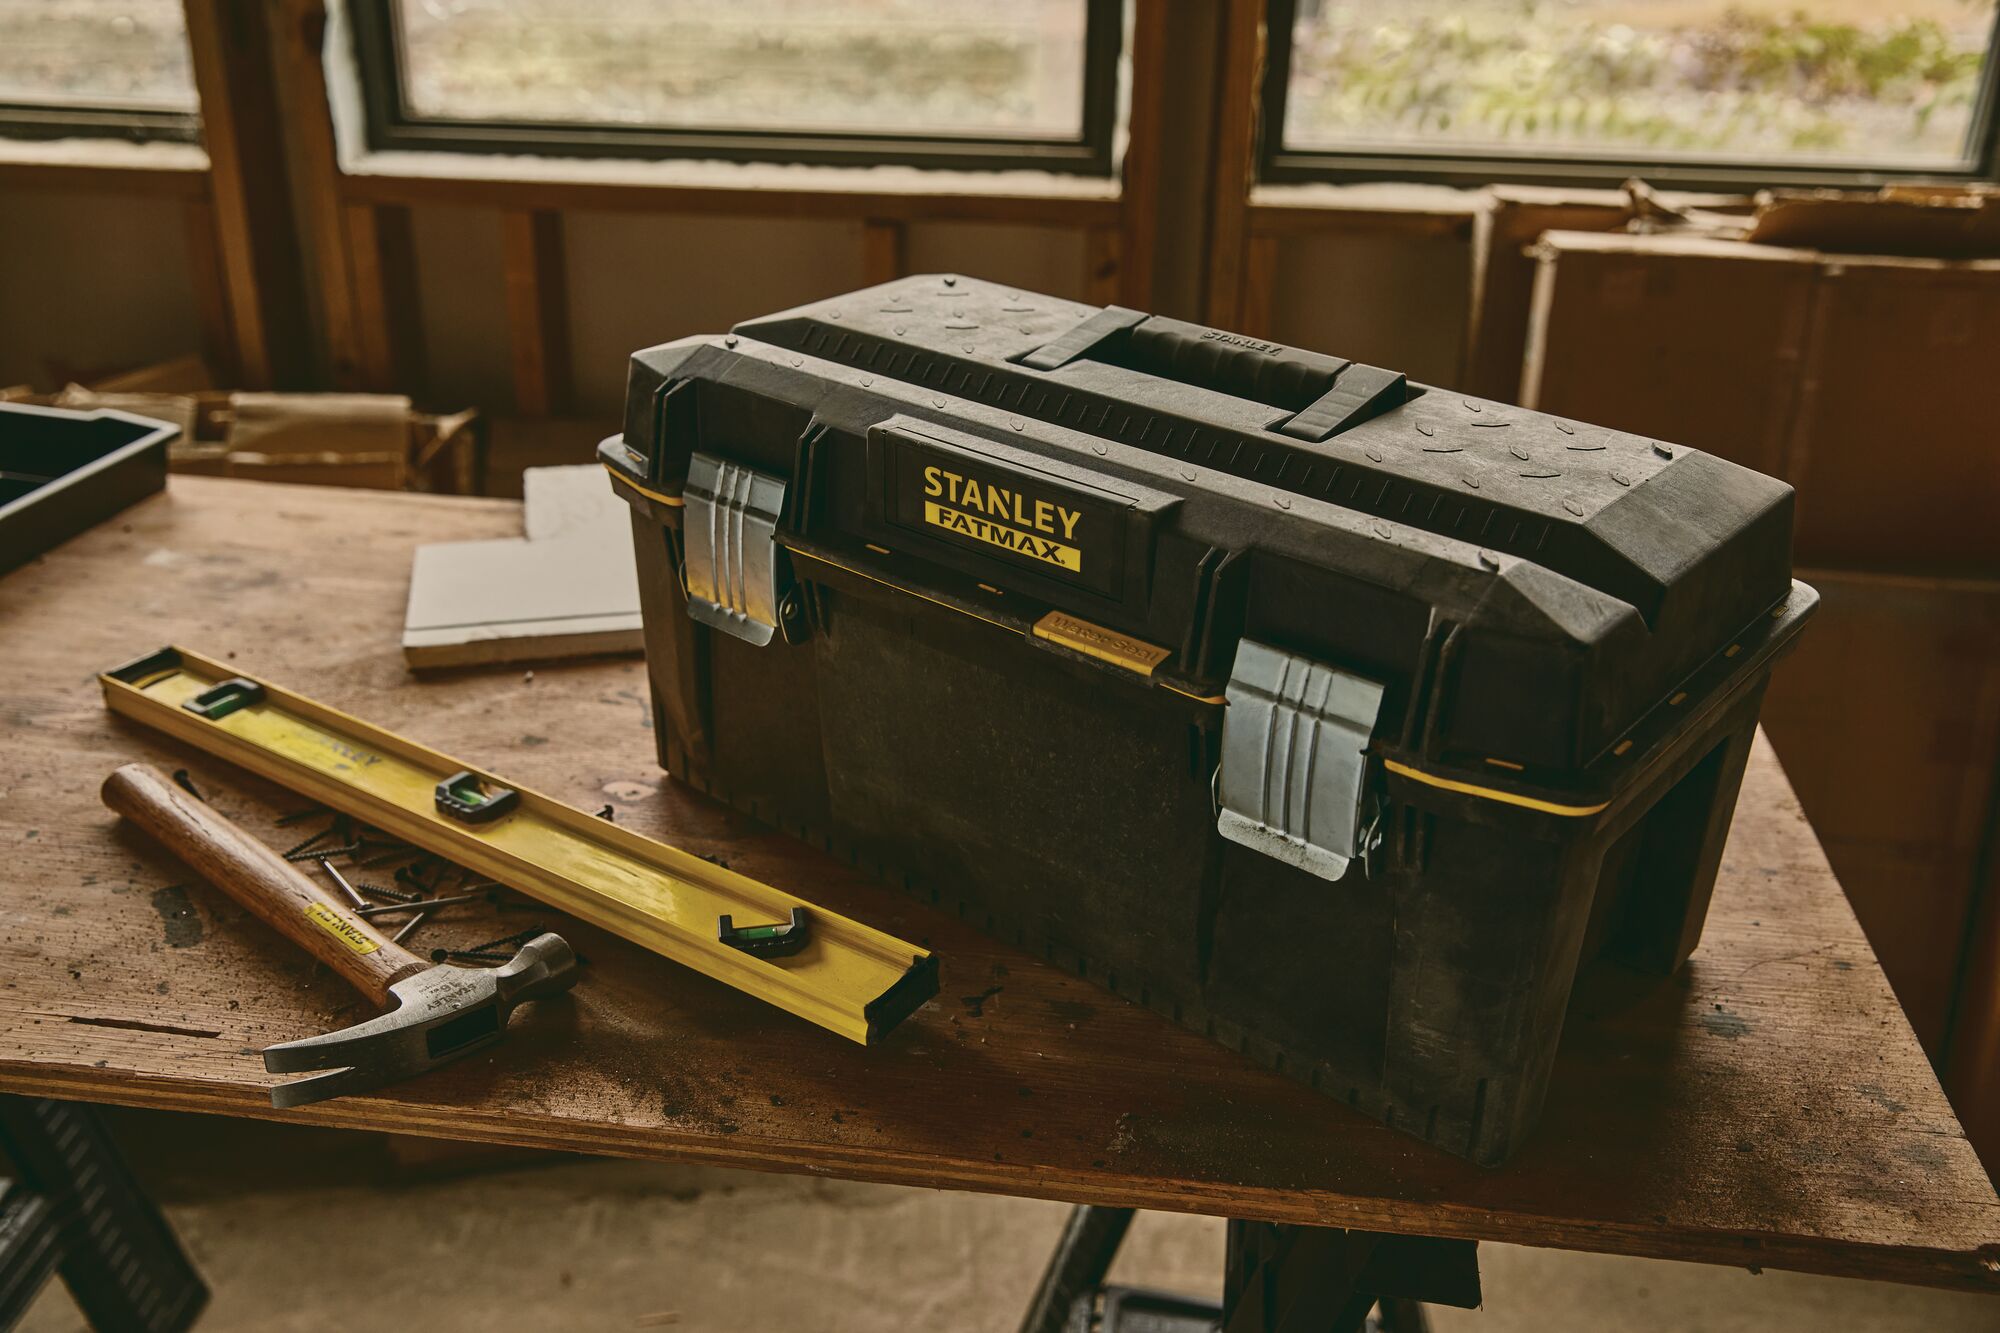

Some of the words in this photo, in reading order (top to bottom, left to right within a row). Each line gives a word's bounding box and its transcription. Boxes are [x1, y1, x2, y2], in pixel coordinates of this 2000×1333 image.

[1201, 331, 1283, 357] STANLEY
[923, 465, 1081, 539] STANLEY
[939, 507, 1062, 563] FATMAX
[1049, 617, 1109, 645] Water
[1111, 640, 1160, 661] Seal
[316, 911, 369, 945] STANLEY
[425, 982, 478, 1011] STANLEY
